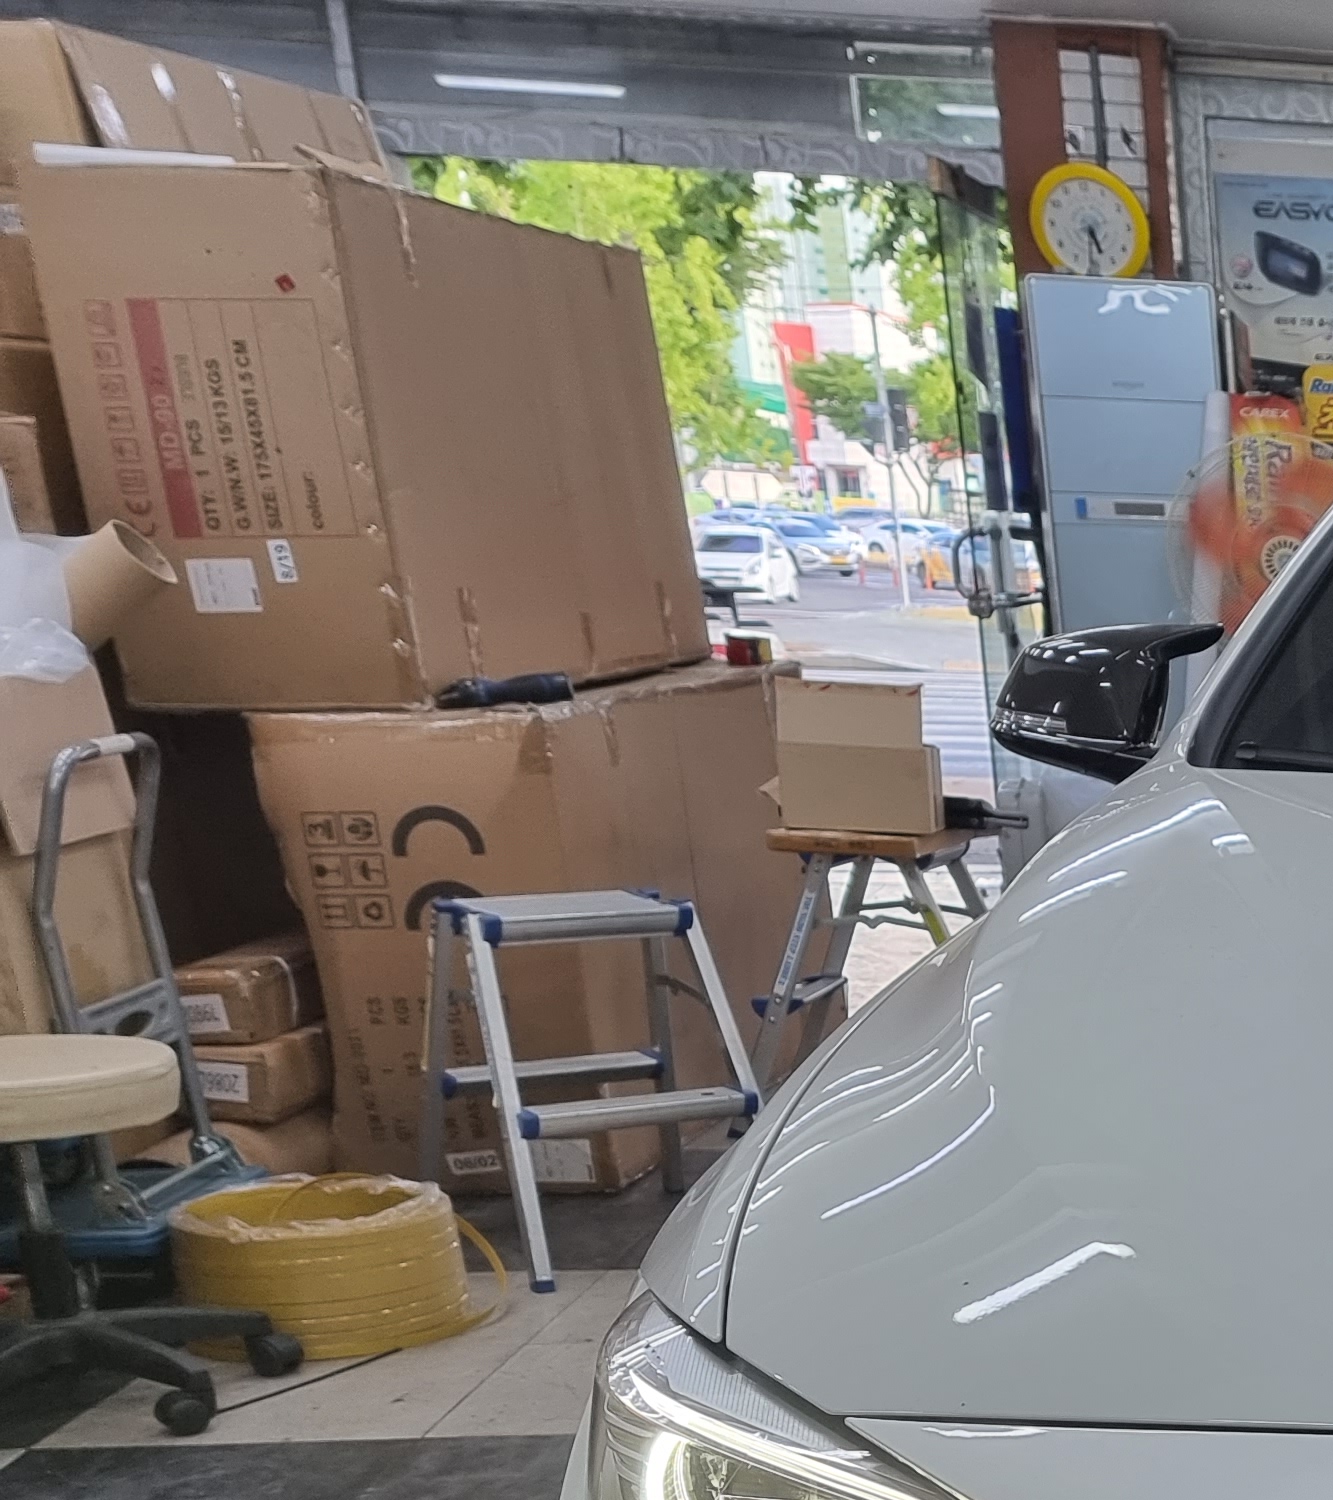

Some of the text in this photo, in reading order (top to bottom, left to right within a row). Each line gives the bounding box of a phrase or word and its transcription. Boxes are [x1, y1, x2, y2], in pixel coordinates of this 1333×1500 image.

[231, 339, 250, 369] CM
[205, 358, 225, 399] KGS
[1240, 406, 1290, 419] CAREX
[185, 419, 205, 457] PCS
[261, 485, 283, 531] SIZE:
[303, 470, 325, 531] colour:
